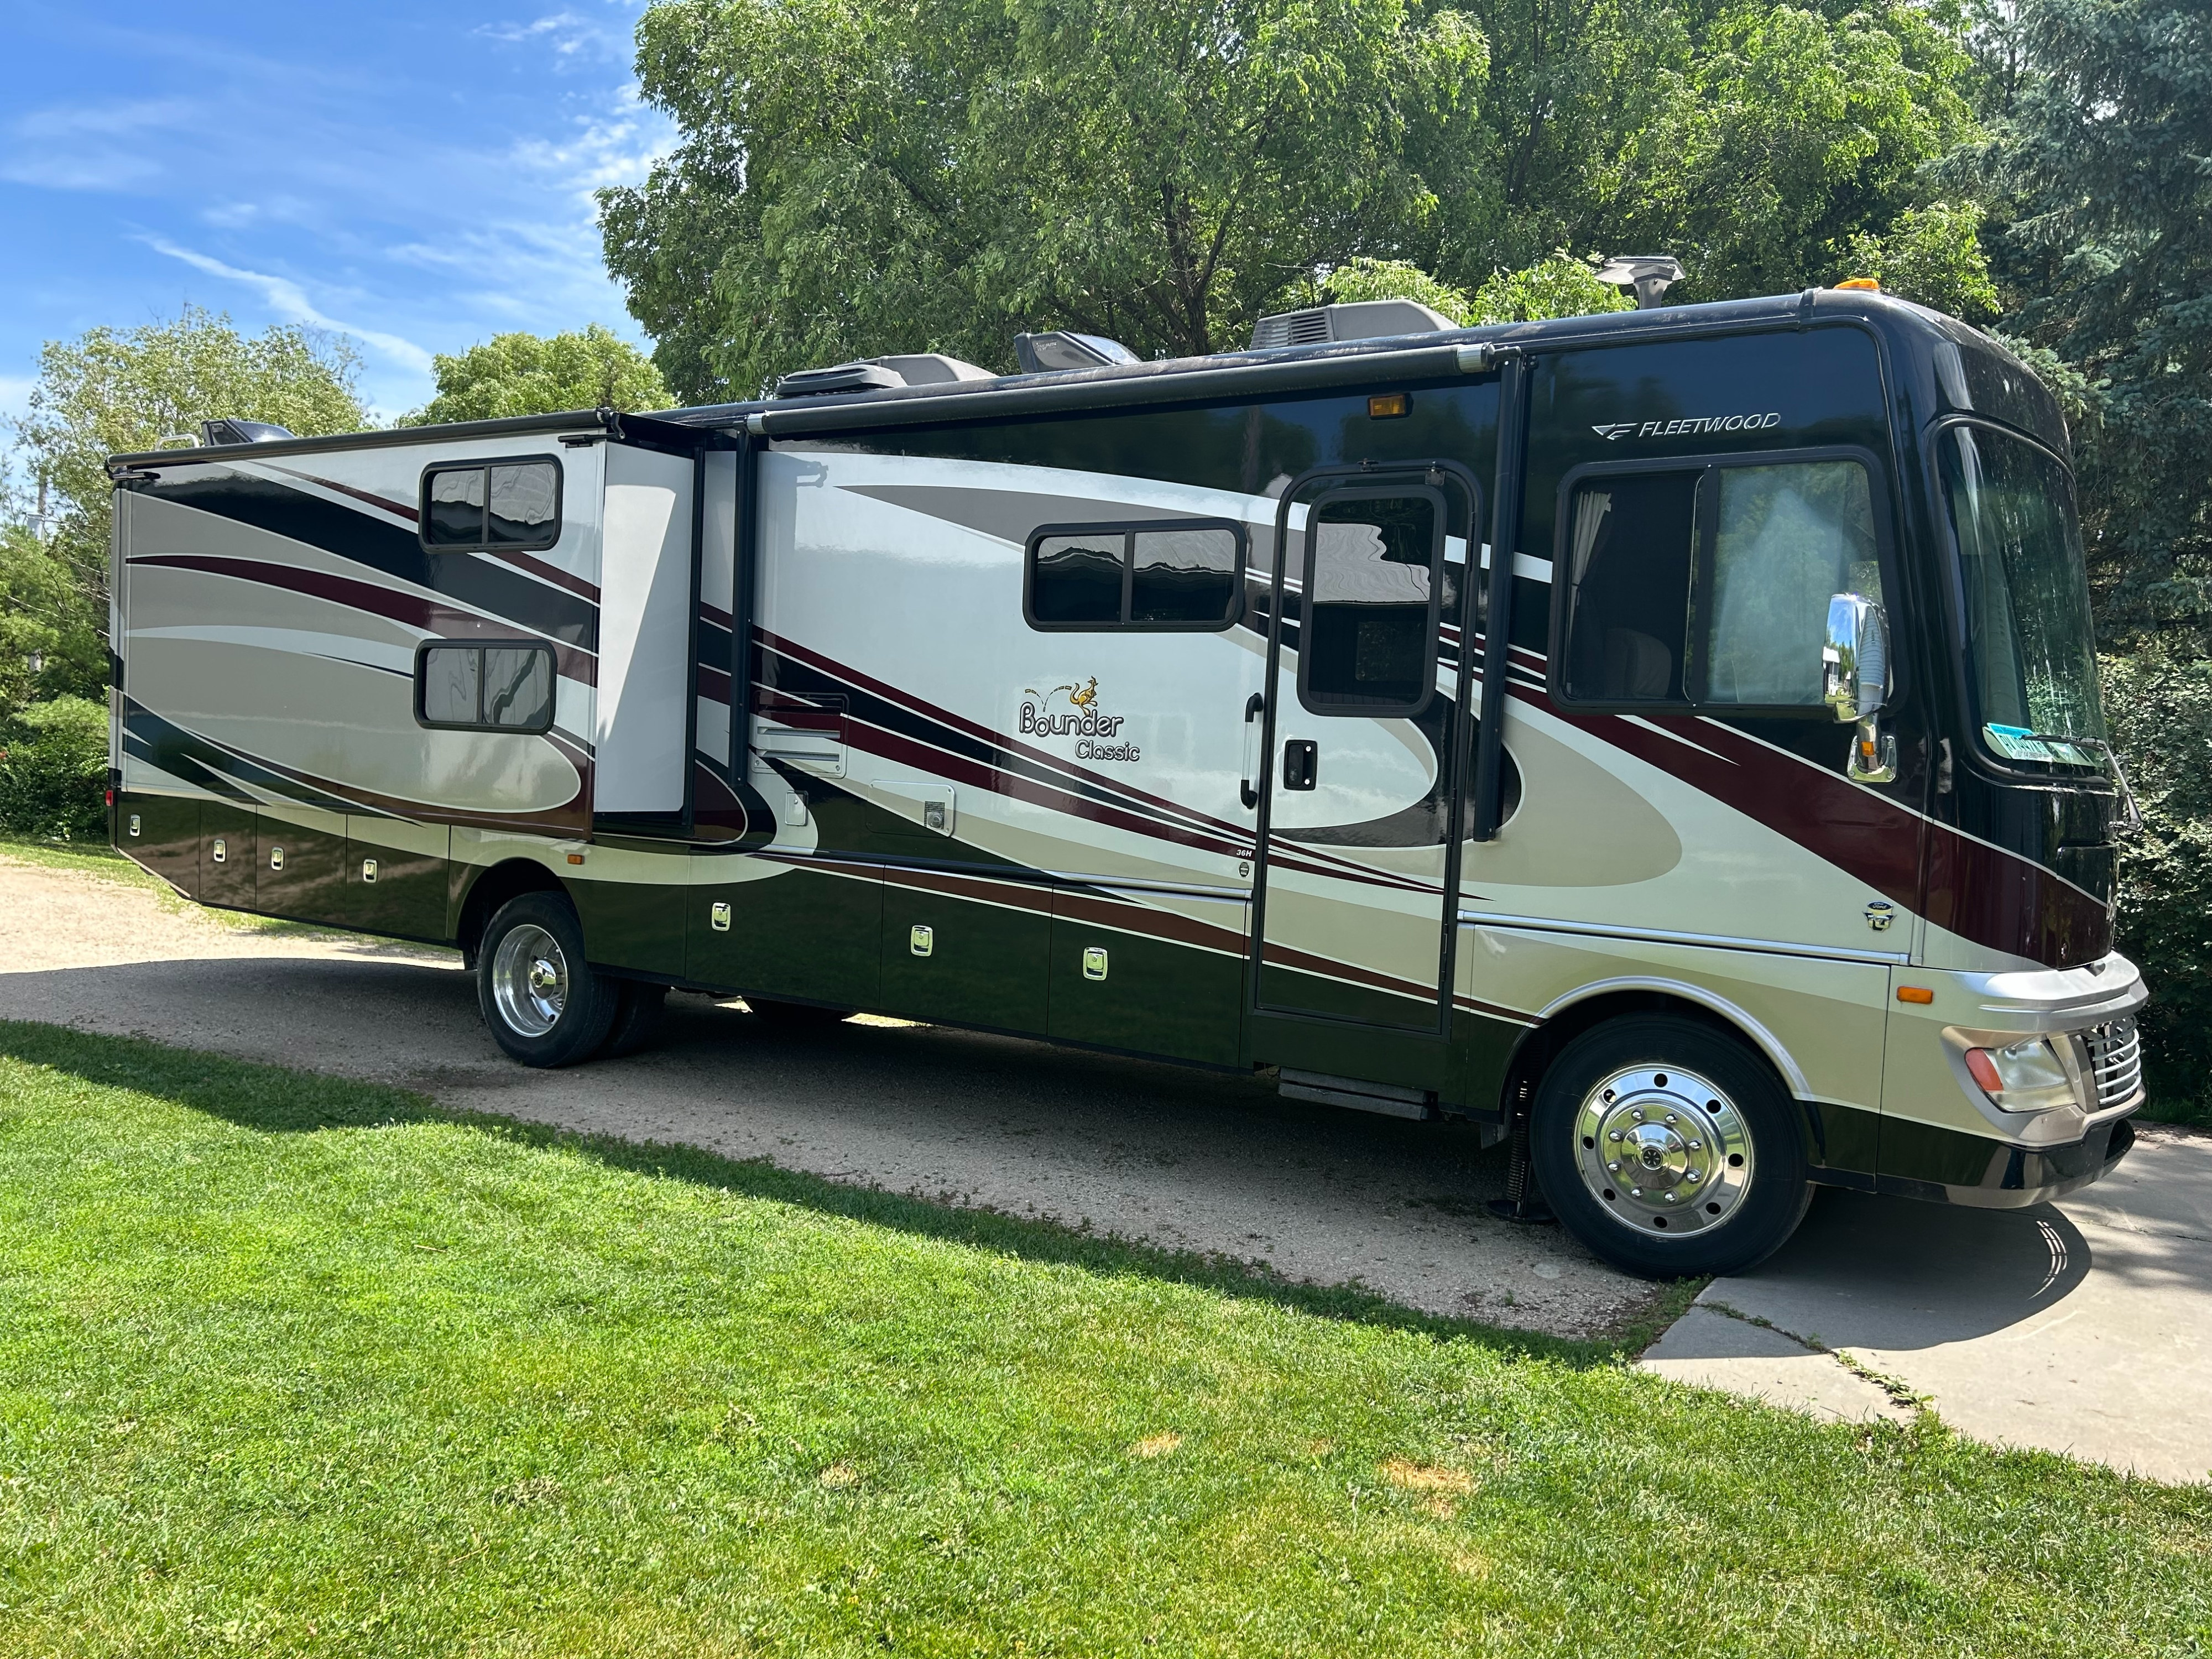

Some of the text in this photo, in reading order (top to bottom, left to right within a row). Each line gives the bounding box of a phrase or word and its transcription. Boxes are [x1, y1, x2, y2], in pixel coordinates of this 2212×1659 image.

[1639, 413, 1781, 437] FLEETWOOD
[1019, 702, 1124, 737] Bounder
[1075, 739, 1140, 761] Classic
